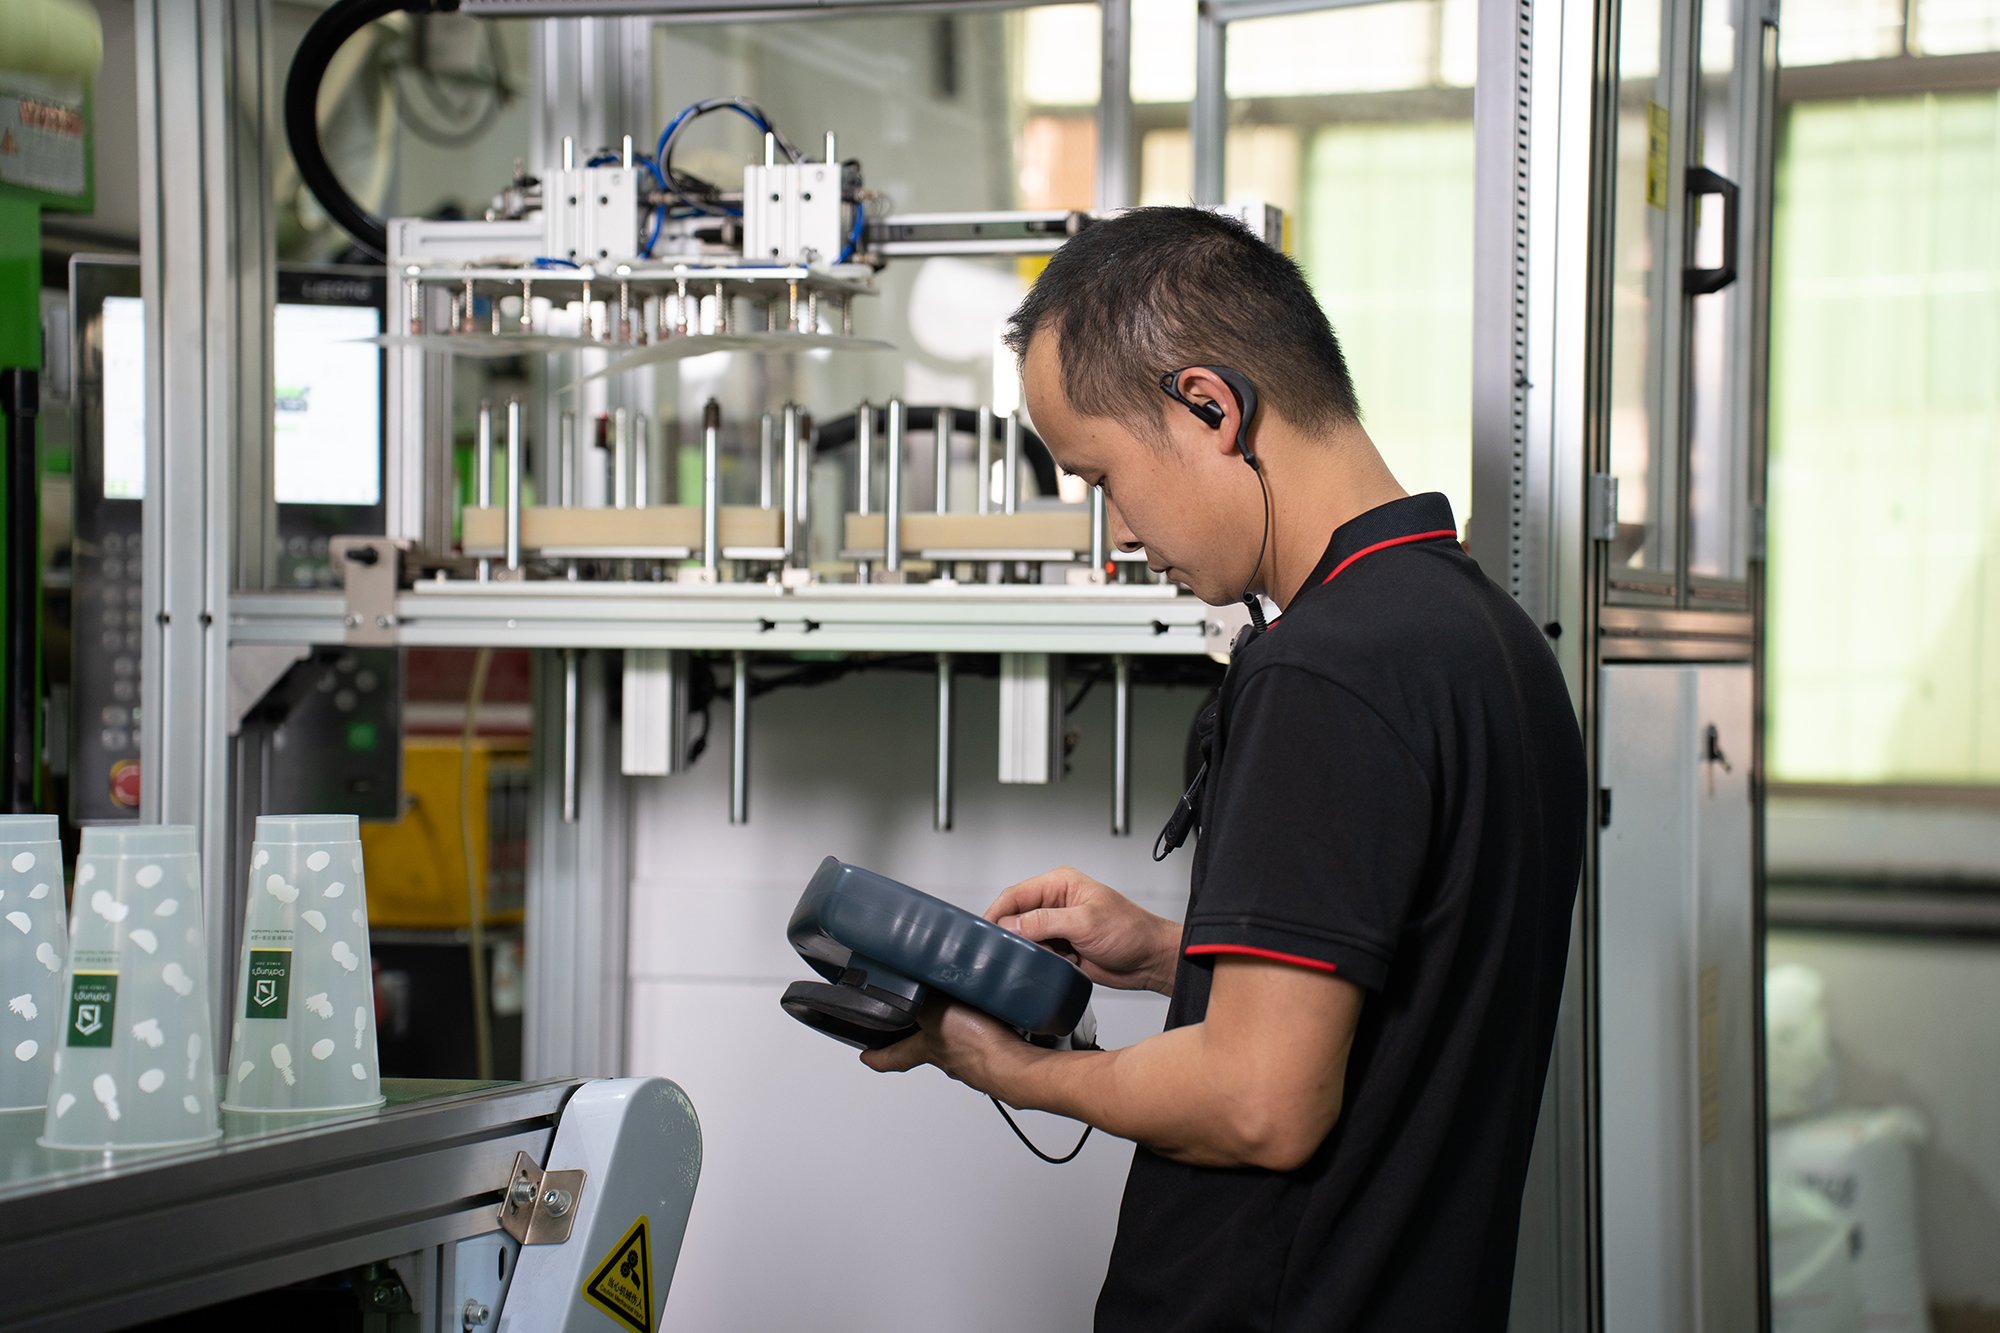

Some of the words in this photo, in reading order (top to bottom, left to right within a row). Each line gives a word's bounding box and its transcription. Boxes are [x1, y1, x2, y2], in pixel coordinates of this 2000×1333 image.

[251, 966, 286, 977] DaYung's
[600, 1284, 615, 1299] Caution
[614, 1294, 634, 1314] Mechanical
[607, 1276, 643, 1310] 当心机械伤人
